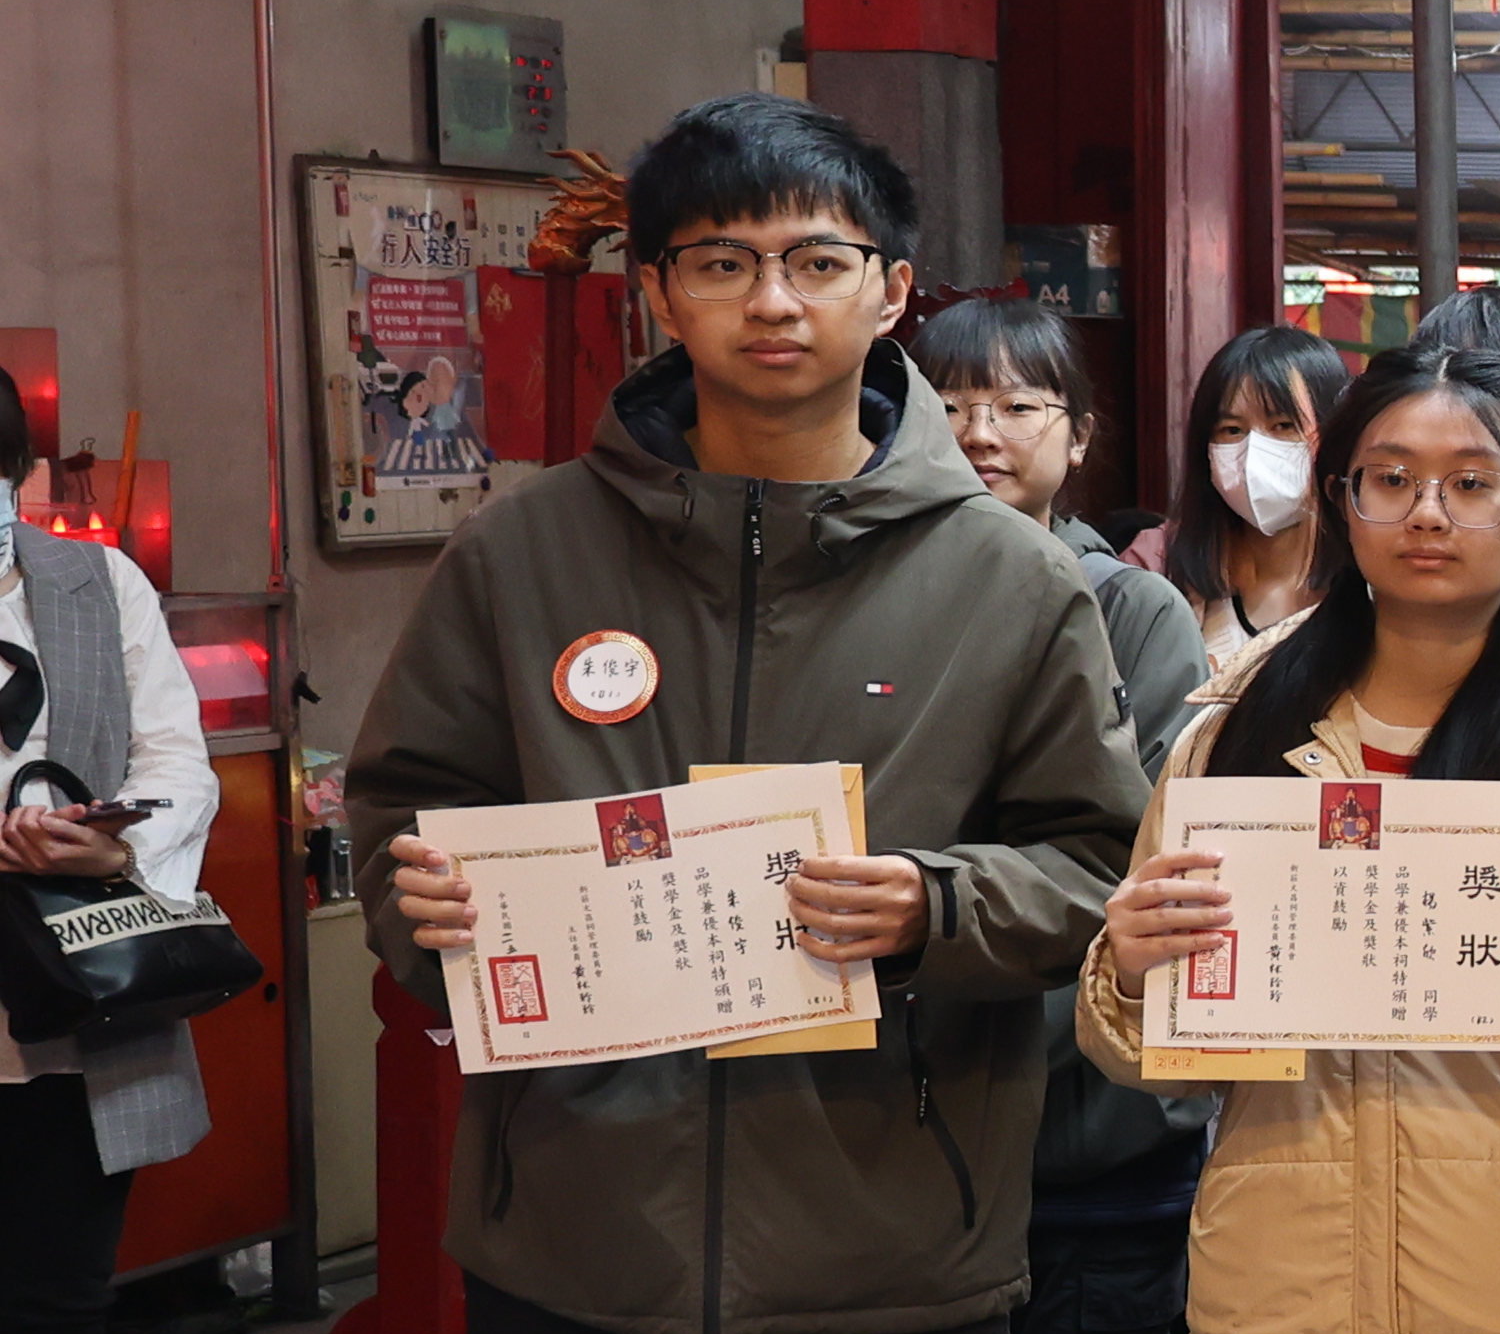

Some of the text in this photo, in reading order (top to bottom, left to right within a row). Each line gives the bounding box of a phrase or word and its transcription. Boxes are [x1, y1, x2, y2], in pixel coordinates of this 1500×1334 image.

[1038, 283, 1070, 304] A4
[627, 879, 653, 943] 以資鼓勵
[1331, 866, 1348, 932] 以資鼓勵
[1362, 865, 1379, 967] 獎學金及獎狀
[1391, 866, 1410, 1021] 品學兼優本祠特頒贈
[748, 977, 766, 1009] 同學
[1422, 989, 1438, 1022] 同學
